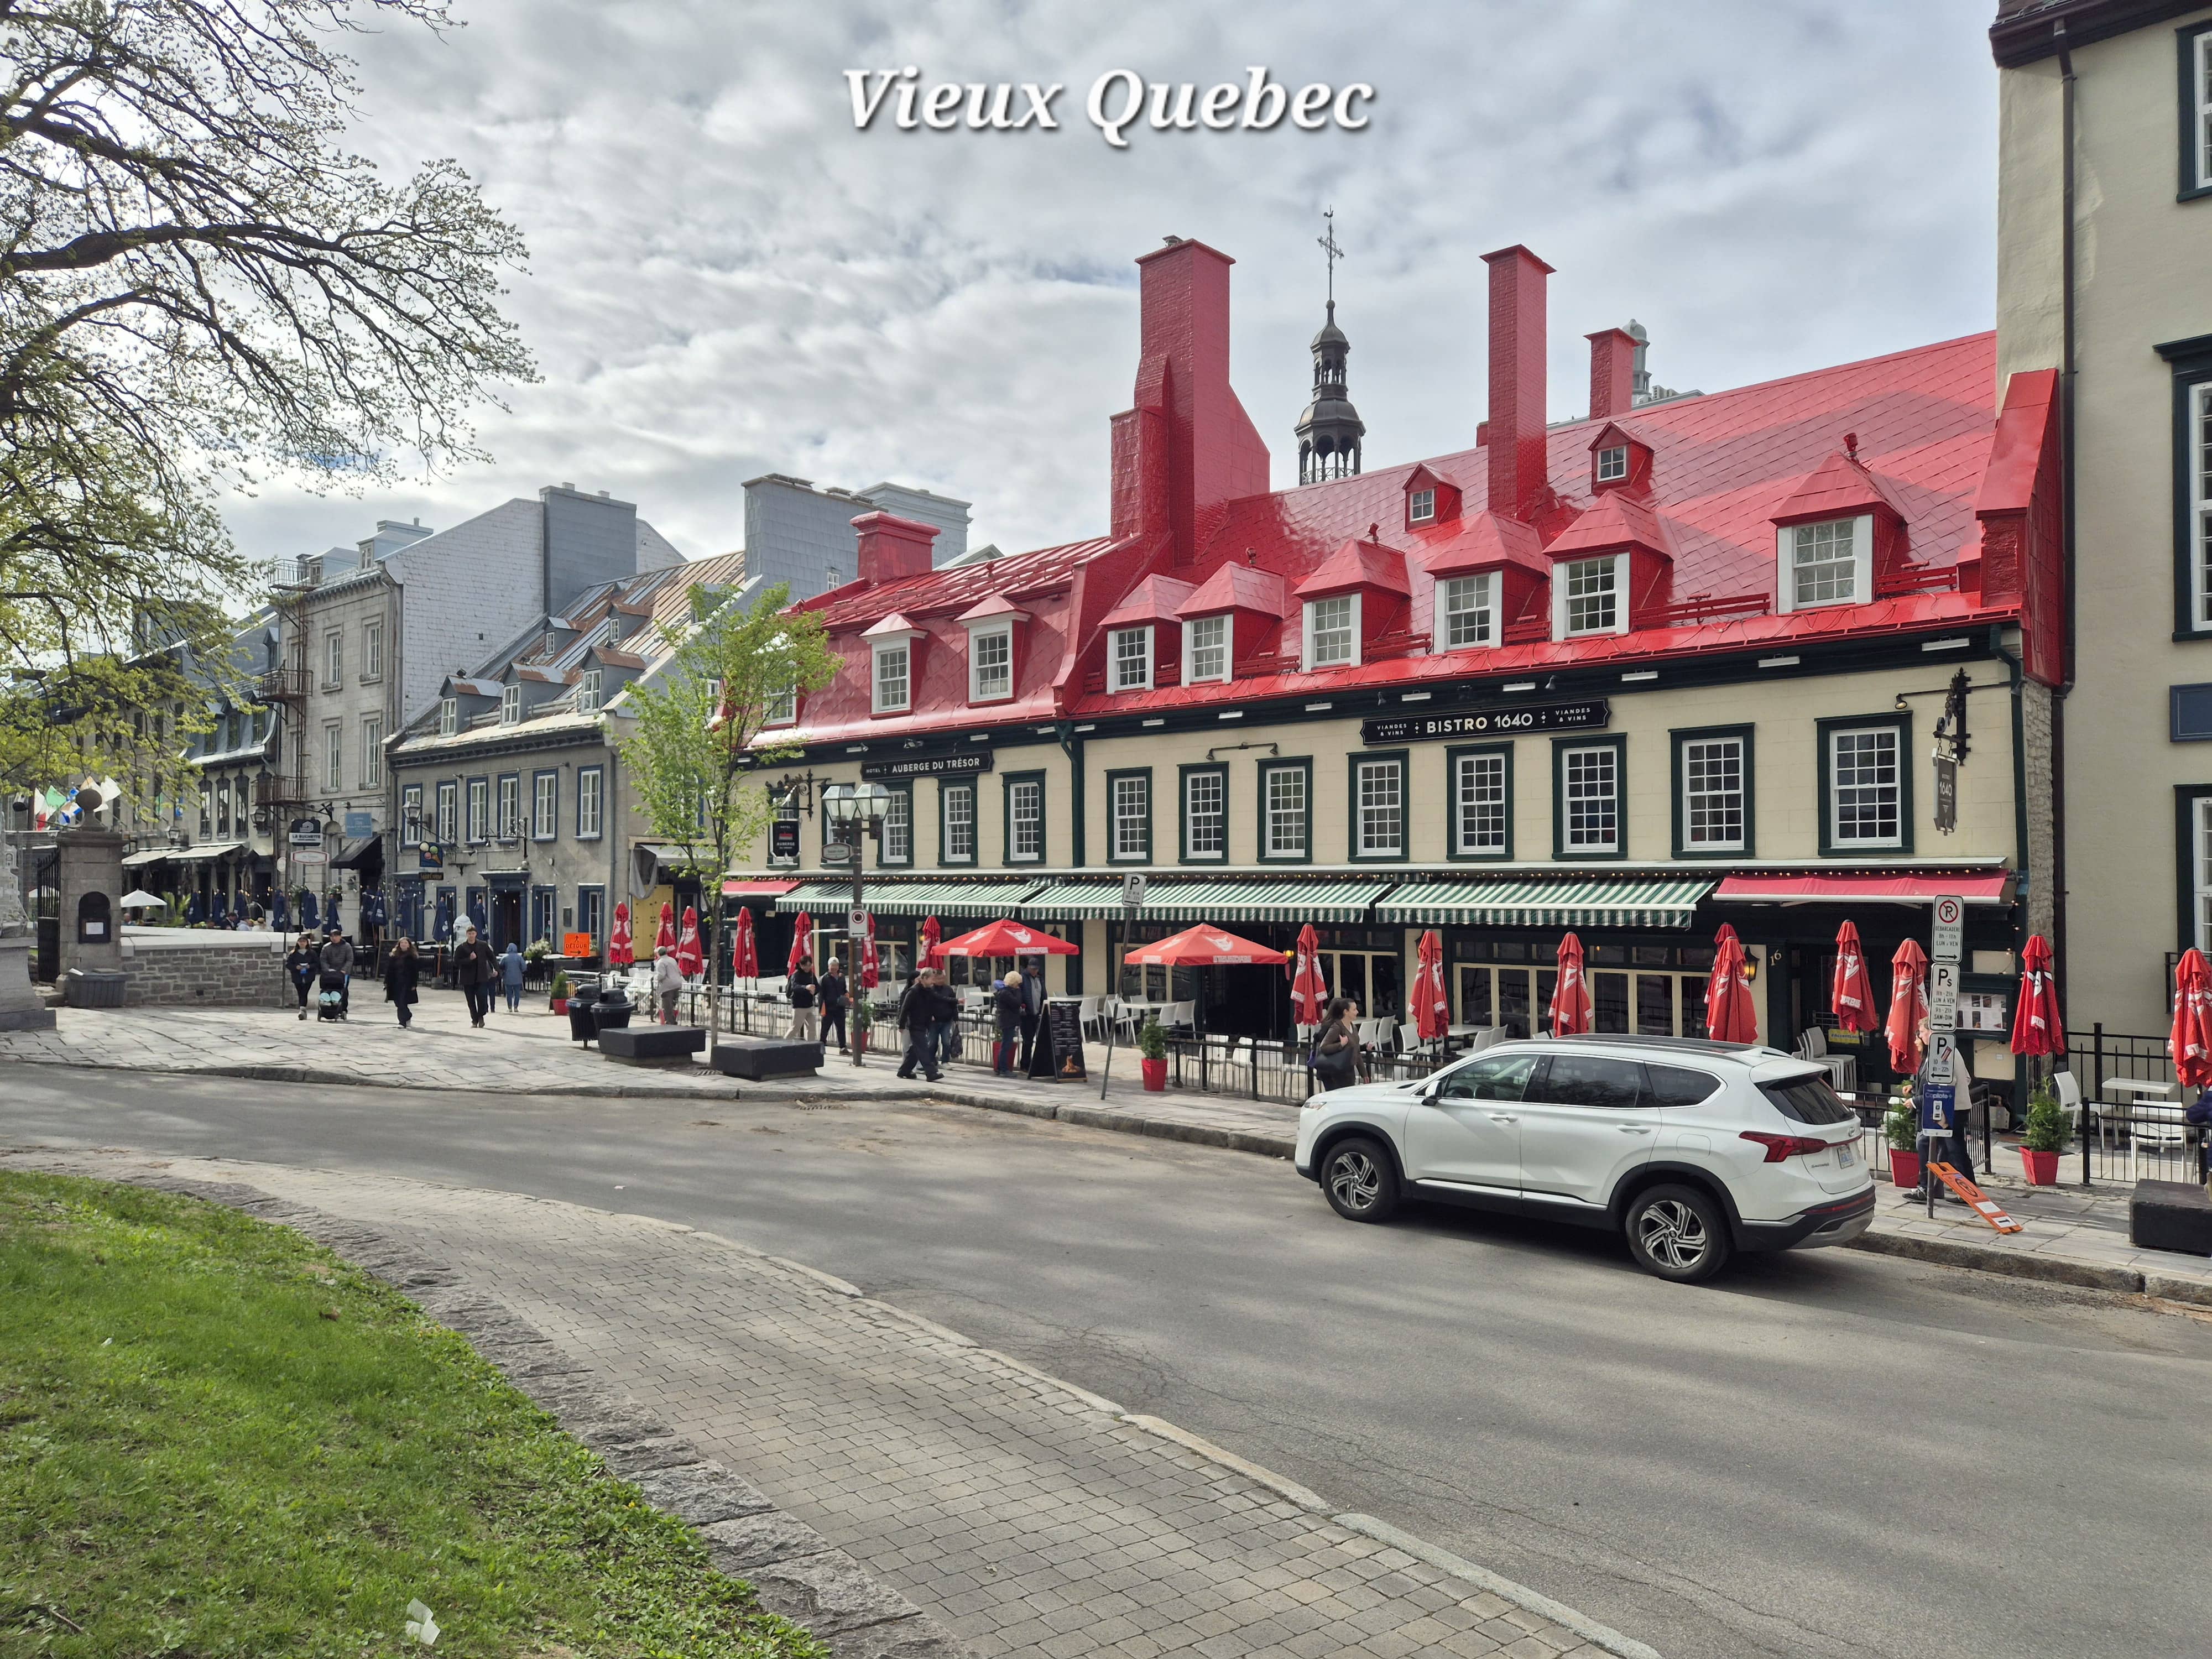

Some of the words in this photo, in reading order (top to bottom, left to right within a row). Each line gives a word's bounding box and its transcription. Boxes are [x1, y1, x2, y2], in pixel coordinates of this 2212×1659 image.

[1555, 707, 1591, 716] VIANDES
[1426, 717, 1488, 734] BISTRO
[1494, 712, 1533, 728] 1640
[892, 762, 930, 773] AUBERGE
[932, 761, 943, 770] DU
[947, 757, 980, 768] TRÉSOR
[1939, 781, 1952, 797] 1640
[1130, 876, 1140, 890] P
[1770, 949, 1782, 966] 16
[1937, 1037, 1947, 1055] P
